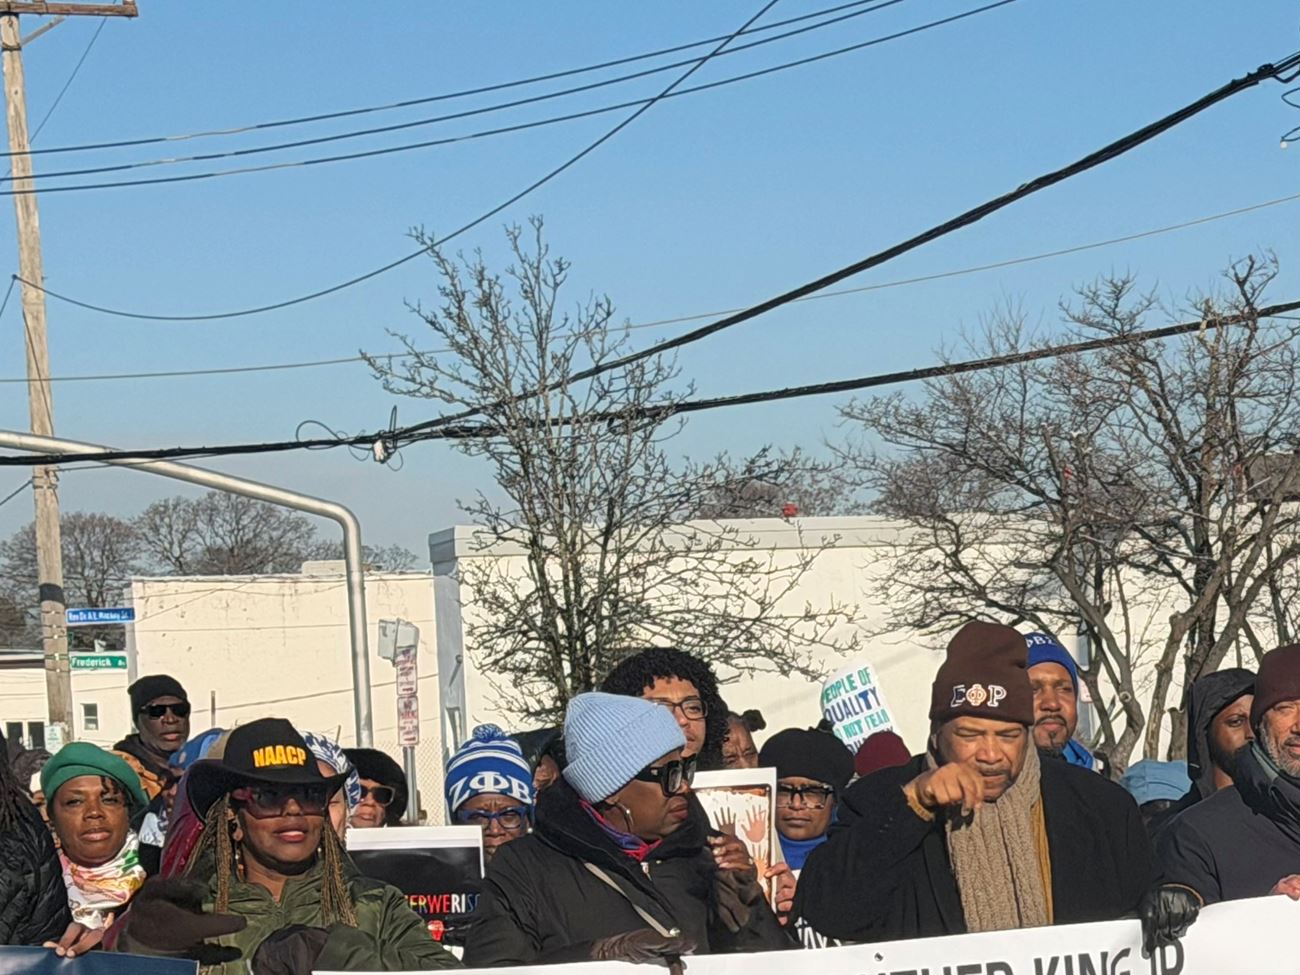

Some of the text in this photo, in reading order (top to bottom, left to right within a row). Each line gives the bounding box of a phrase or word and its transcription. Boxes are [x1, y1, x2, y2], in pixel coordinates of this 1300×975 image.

[72, 657, 112, 667] Frederick
[857, 666, 872, 686] OF
[824, 686, 881, 725] QUALITY
[253, 744, 306, 768] NAACP
